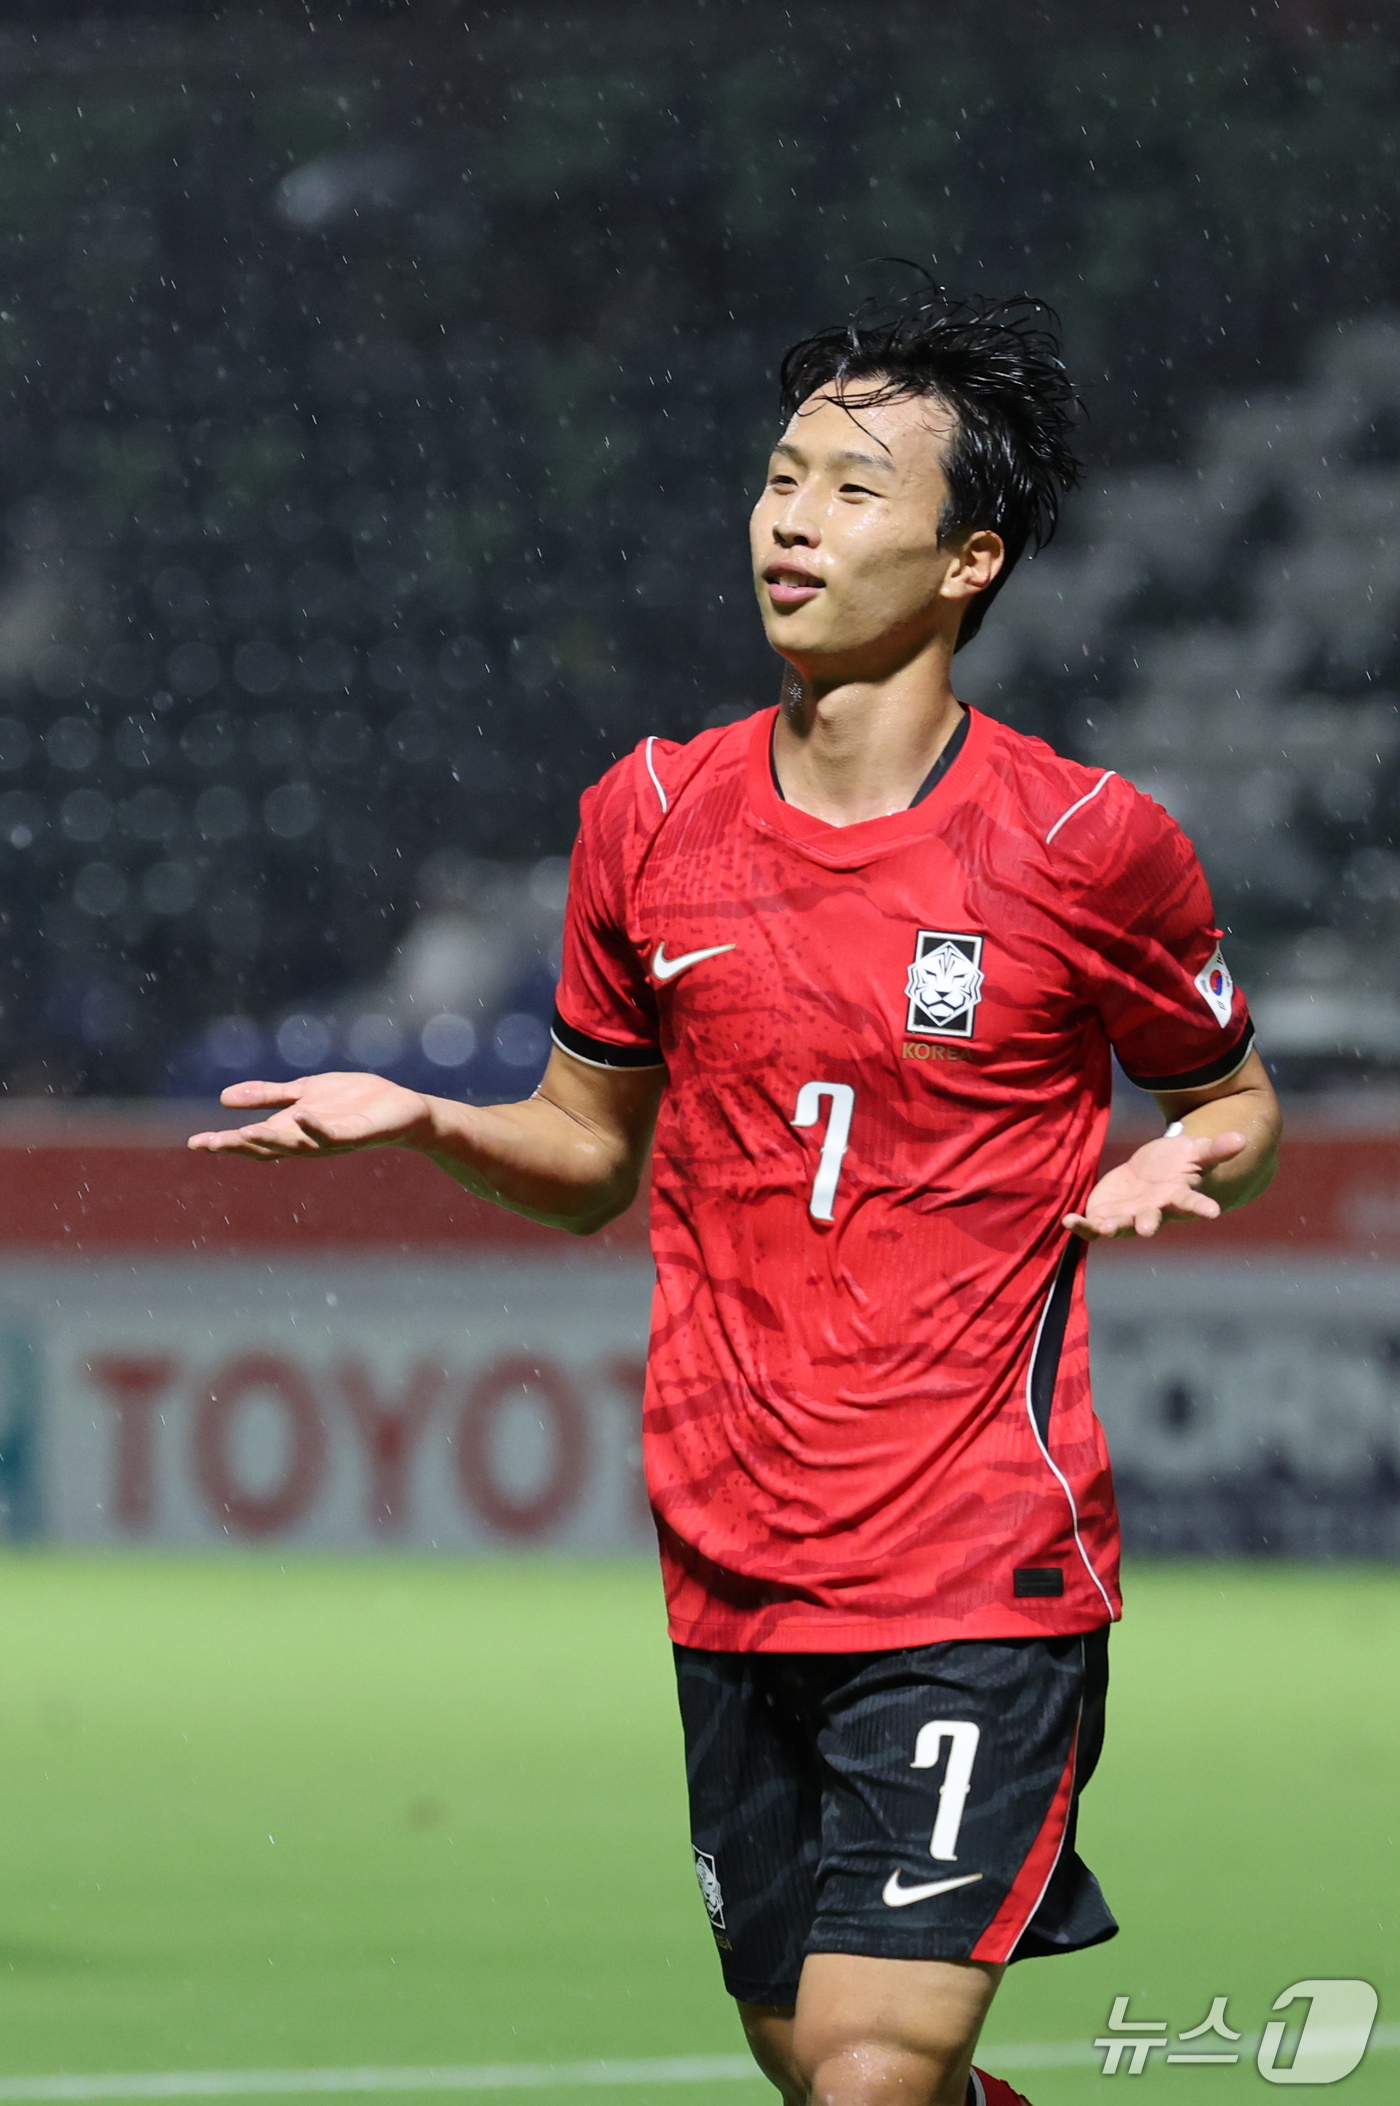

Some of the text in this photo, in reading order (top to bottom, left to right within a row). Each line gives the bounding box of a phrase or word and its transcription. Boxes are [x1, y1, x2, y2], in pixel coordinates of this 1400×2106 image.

[901, 1042, 973, 1061] KOREA
[789, 1080, 855, 1221] 7
[909, 1719, 980, 1861] 7
